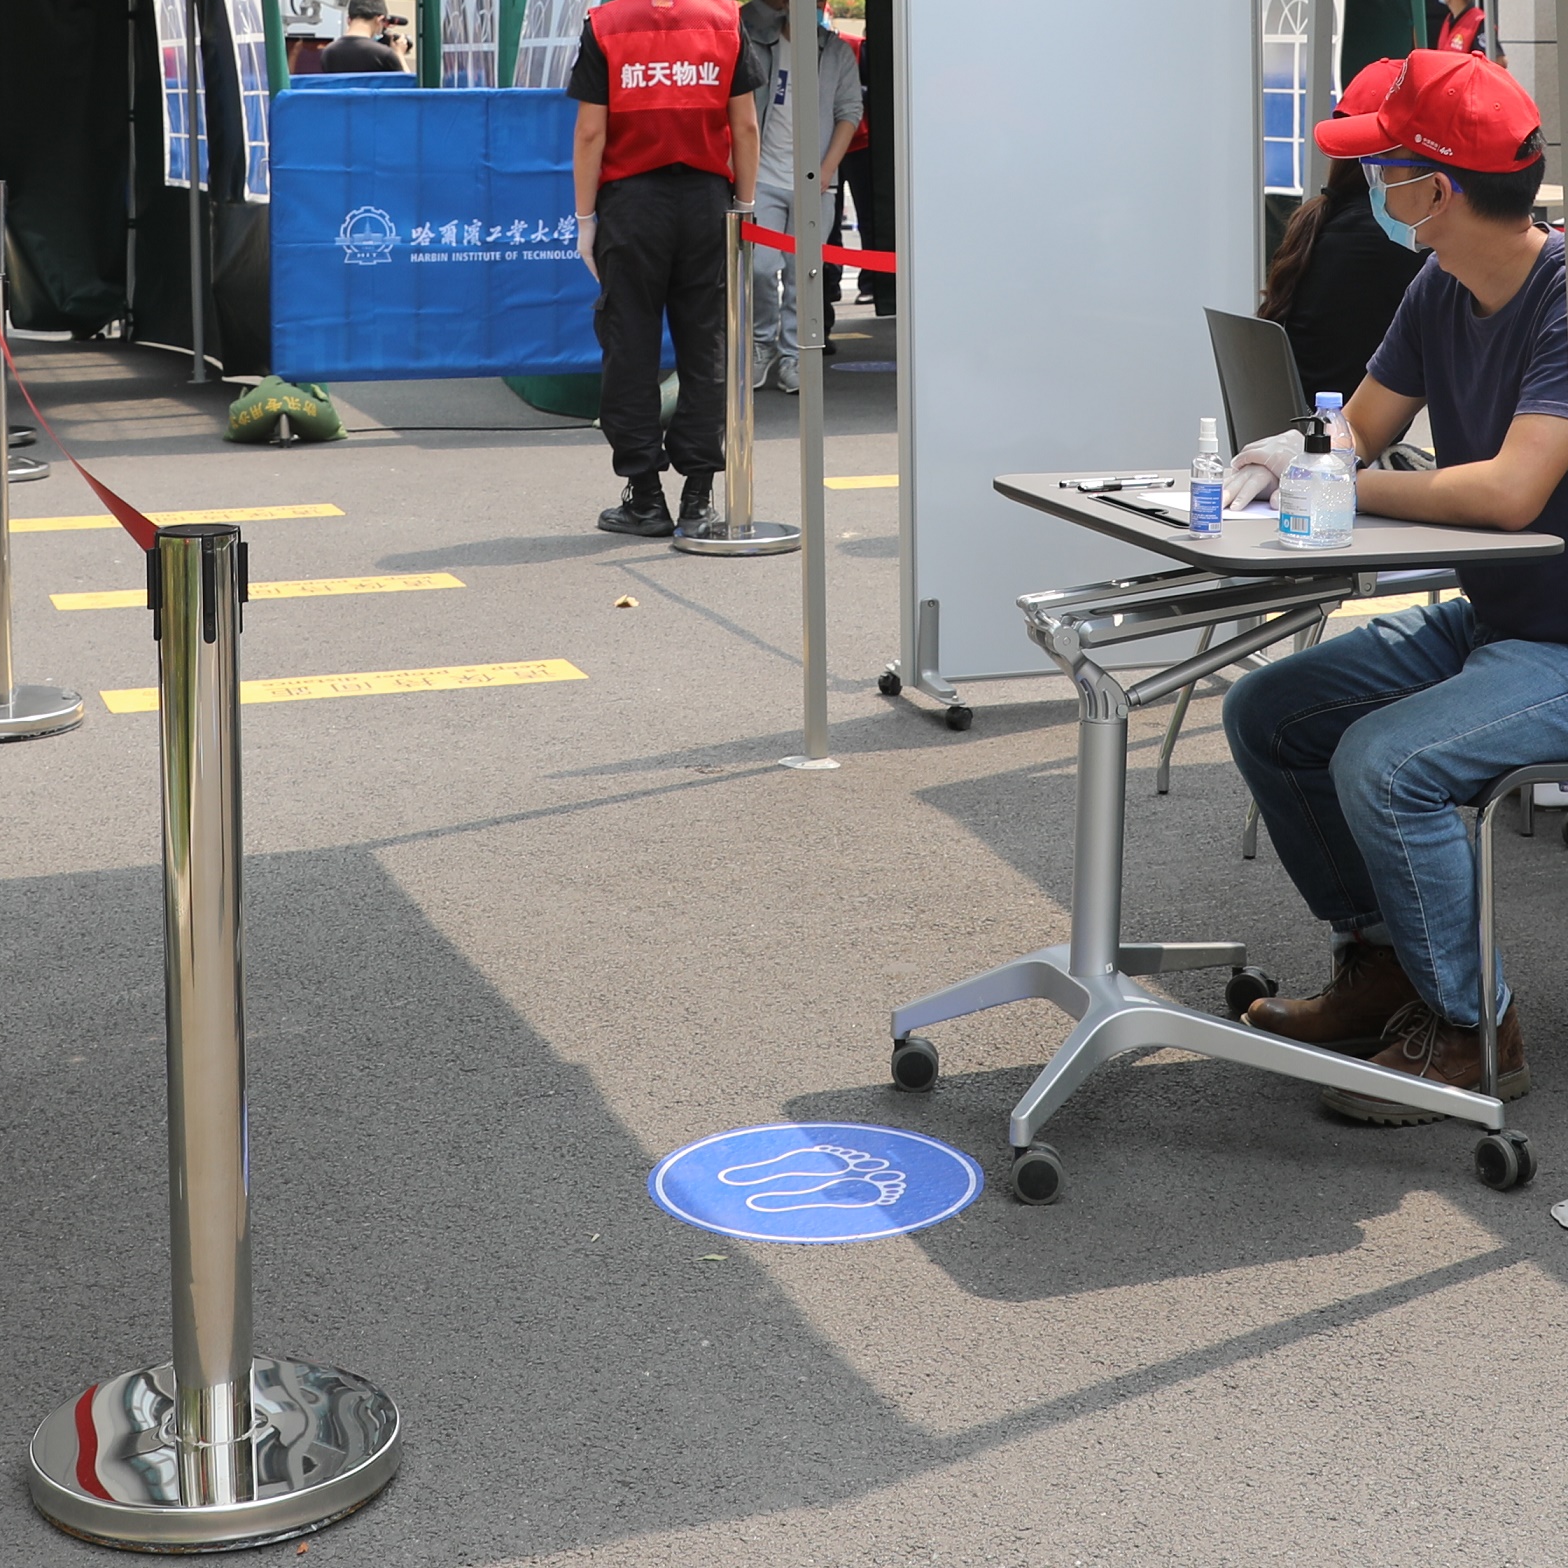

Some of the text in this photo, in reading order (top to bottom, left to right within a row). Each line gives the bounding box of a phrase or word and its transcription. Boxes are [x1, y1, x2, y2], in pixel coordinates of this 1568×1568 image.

[621, 62, 720, 89] 航天物业
[410, 249, 581, 263] HARBIN INSTITUTE OF TECHNOLOG
